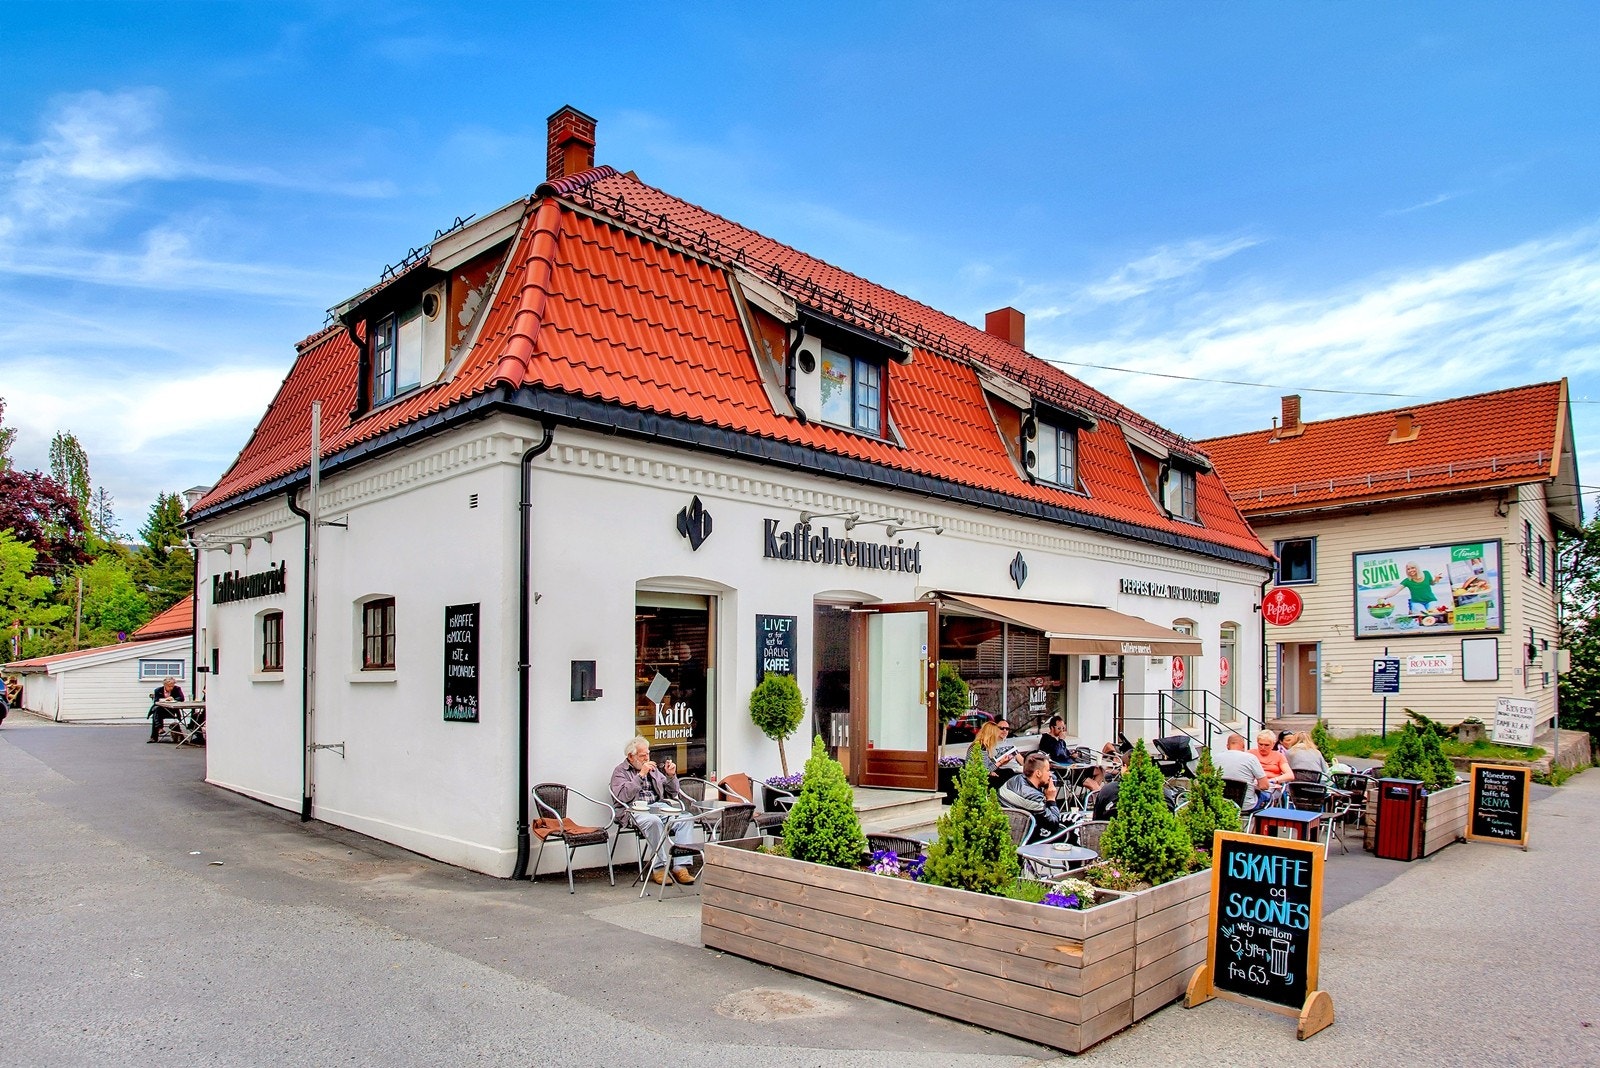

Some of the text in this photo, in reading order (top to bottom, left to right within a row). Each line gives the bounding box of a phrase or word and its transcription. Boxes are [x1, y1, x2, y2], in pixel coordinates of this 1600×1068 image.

[762, 518, 922, 574] Kaffebrenneriet
[1362, 562, 1400, 586] SUNN
[1120, 578, 1149, 597] PEPPES
[1149, 582, 1168, 599] PIZZA
[1266, 602, 1297, 616] Peppes
[764, 618, 792, 632] LIVET
[763, 645, 789, 658] DÅRLIG
[448, 664, 476, 678] LIMONADE
[763, 657, 790, 671] KAFFE
[655, 701, 694, 726] Kaffe
[654, 726, 693, 740] brenneriet
[1482, 770, 1516, 780] Månedens
[1481, 789, 1499, 798] kaffe
[1481, 797, 1511, 808] KENYA
[1228, 851, 1309, 887] ISKAFFE
[1269, 887, 1287, 906] og
[1225, 892, 1309, 931] SCONES
[1237, 922, 1293, 941] velg mellom
[1230, 934, 1268, 958] 3 typer
[1228, 962, 1246, 979] fra
